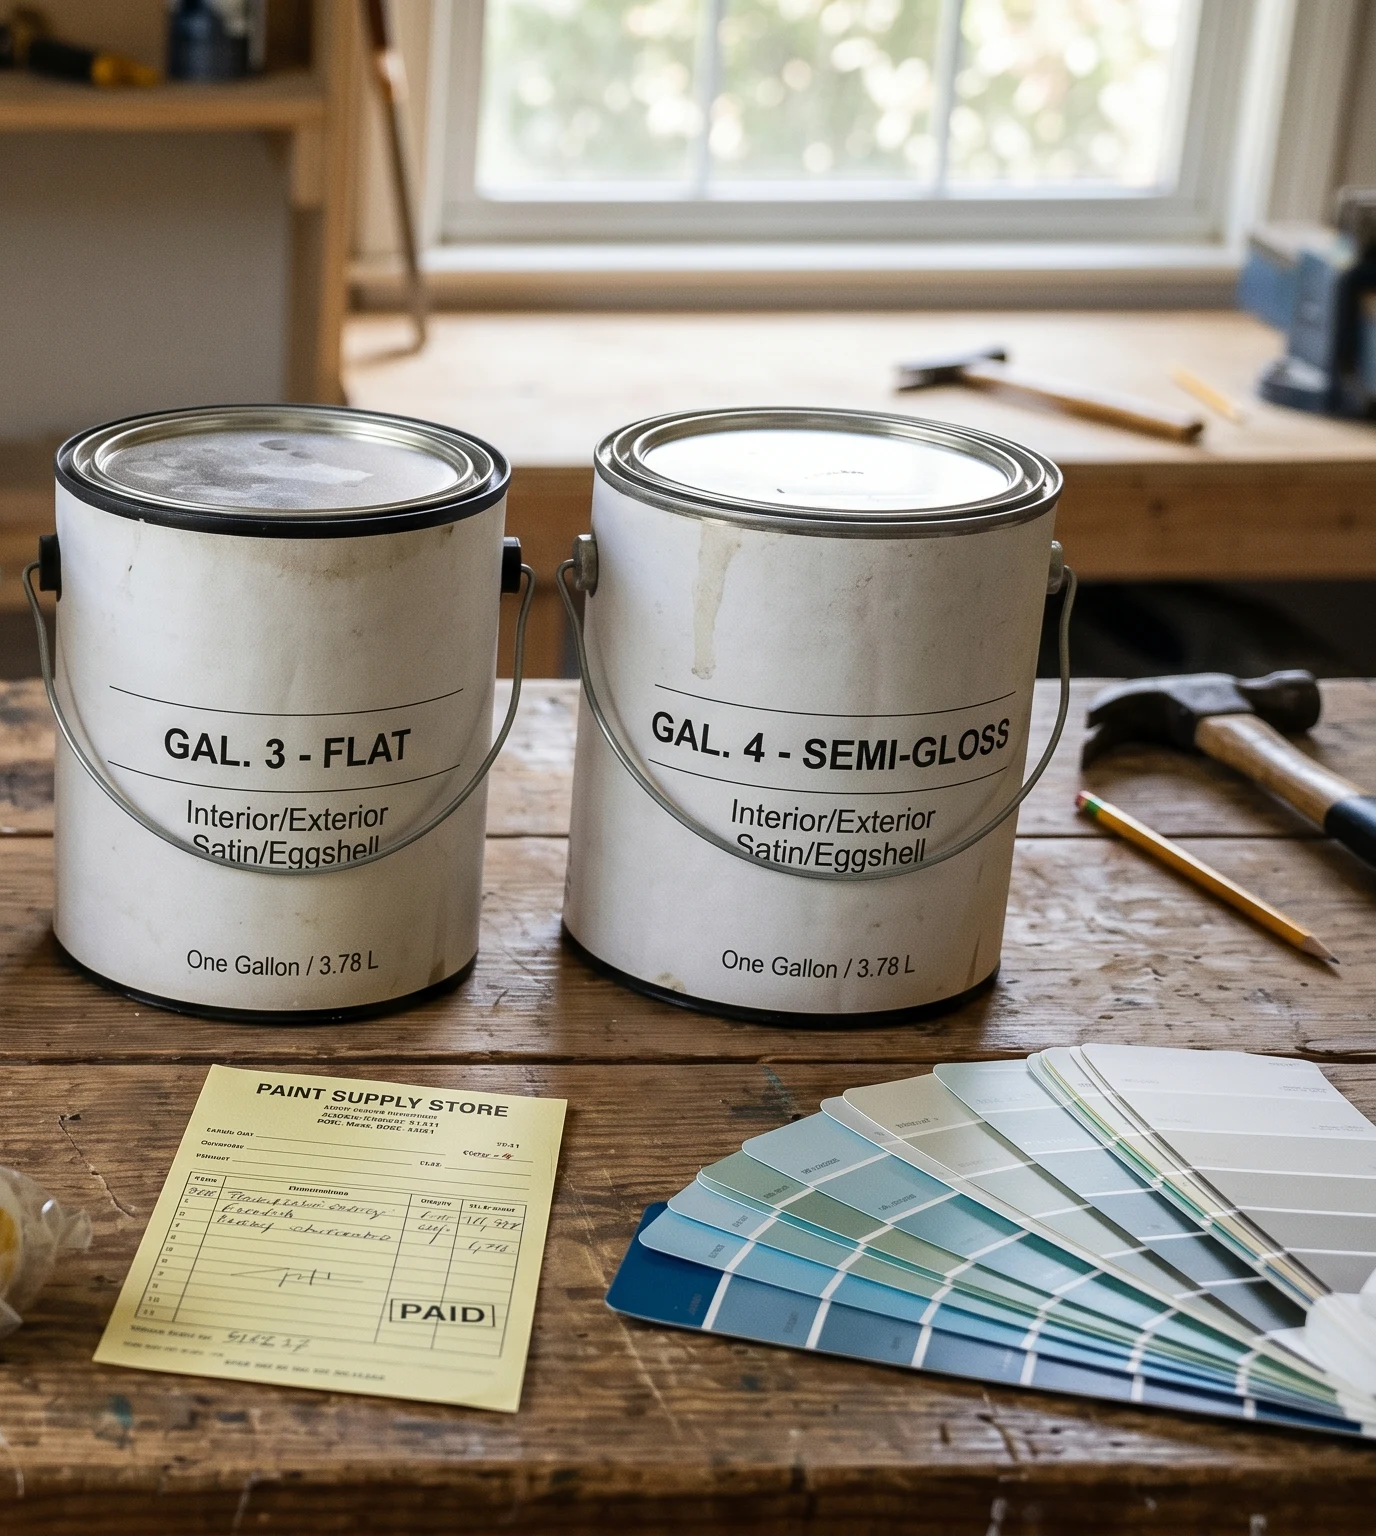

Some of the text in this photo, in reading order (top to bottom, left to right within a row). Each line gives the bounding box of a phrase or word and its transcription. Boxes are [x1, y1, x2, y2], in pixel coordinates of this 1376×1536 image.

[164, 728, 251, 767] GAL.
[265, 739, 286, 769] 3
[324, 729, 412, 768] FLAT
[652, 711, 730, 759] GAL.
[743, 732, 766, 763] 4
[803, 718, 1010, 770] SEMI-GLOSS
[187, 800, 389, 832] Interior/Exterior
[731, 799, 936, 834] Interior/Exterior
[193, 834, 380, 869] Satin/Eggshell
[737, 833, 926, 873] Satin/Eggshell
[187, 949, 379, 977] One Gallon / 3.78 L
[722, 949, 916, 980] One Gallon / 3.78 L
[256, 1083, 327, 1101] PAINT
[331, 1089, 423, 1110] SUPPLY
[428, 1098, 509, 1118] STORE
[400, 1303, 486, 1323] PAID
